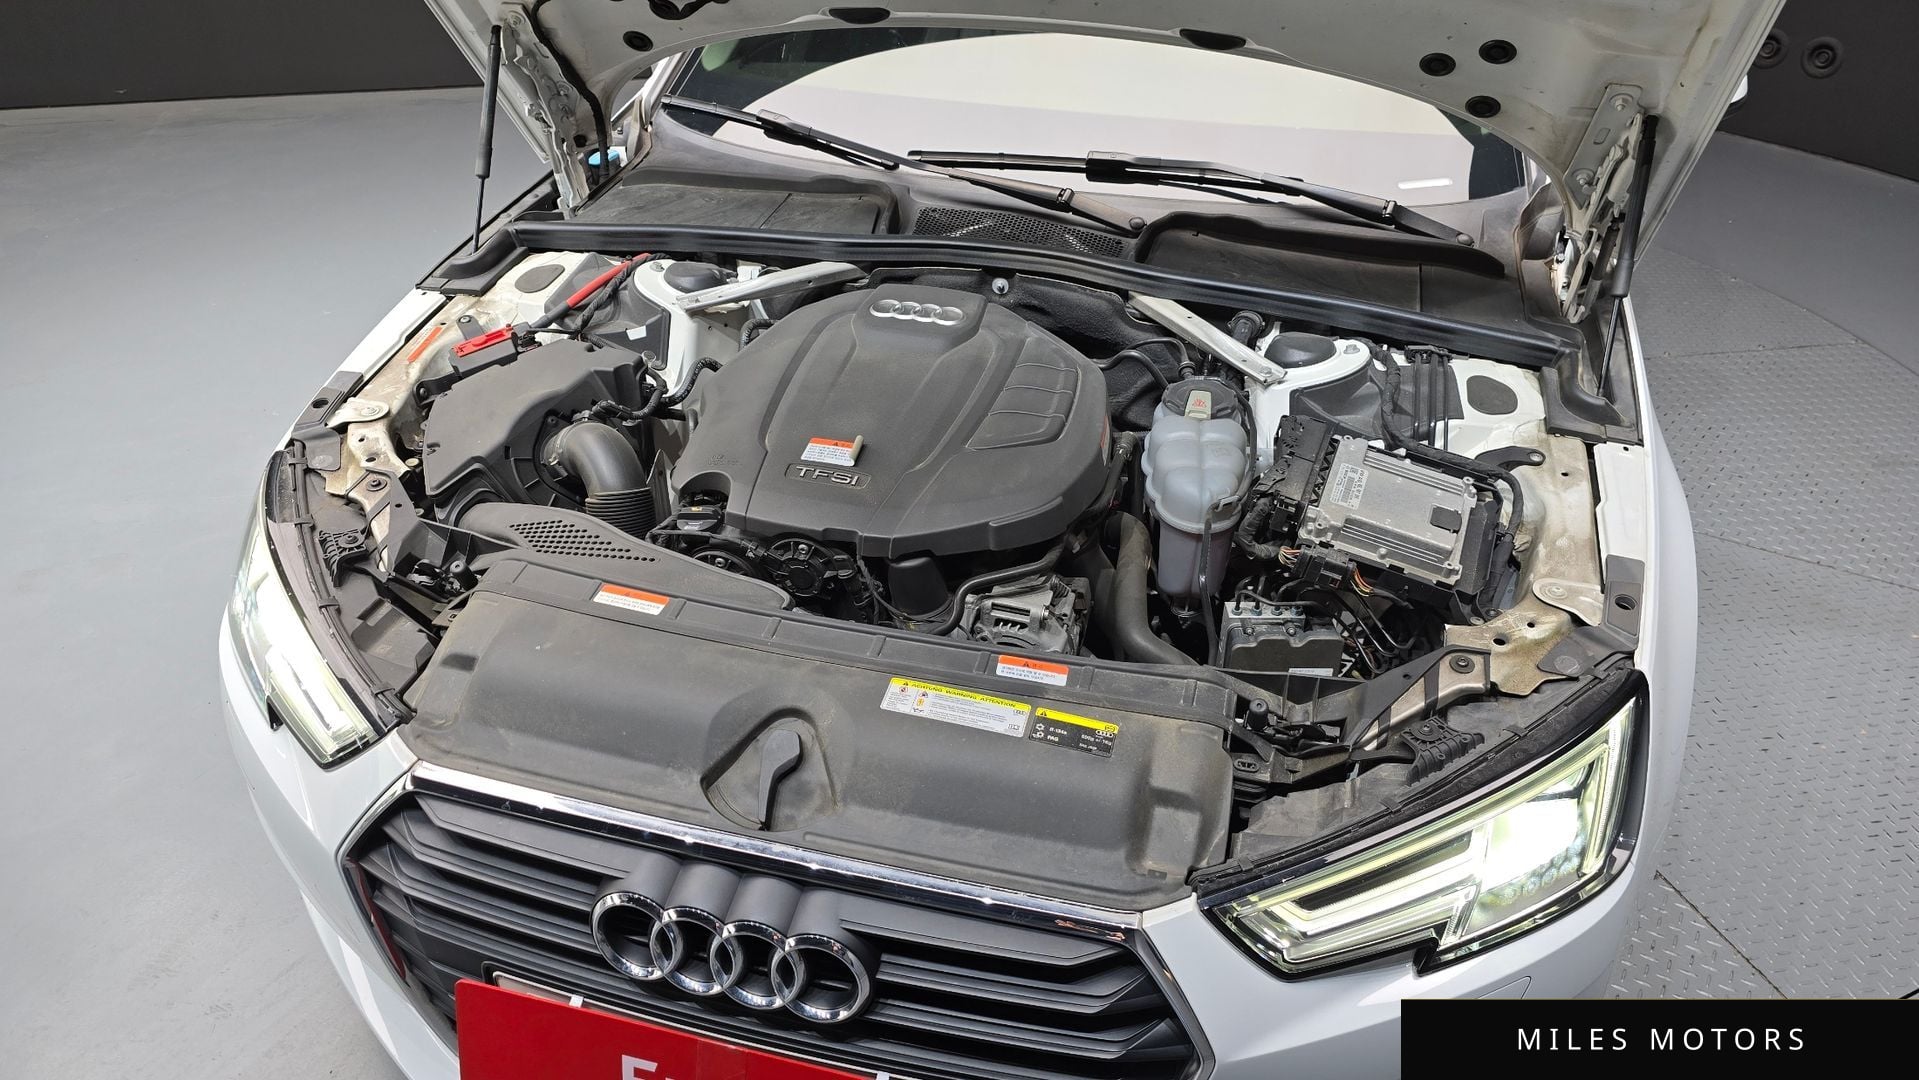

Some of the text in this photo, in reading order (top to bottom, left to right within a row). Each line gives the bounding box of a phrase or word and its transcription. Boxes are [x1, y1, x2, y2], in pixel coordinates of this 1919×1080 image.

[796, 466, 859, 486] TFSI
[945, 689, 977, 700] WARNING
[980, 697, 1017, 708] ATTENTION
